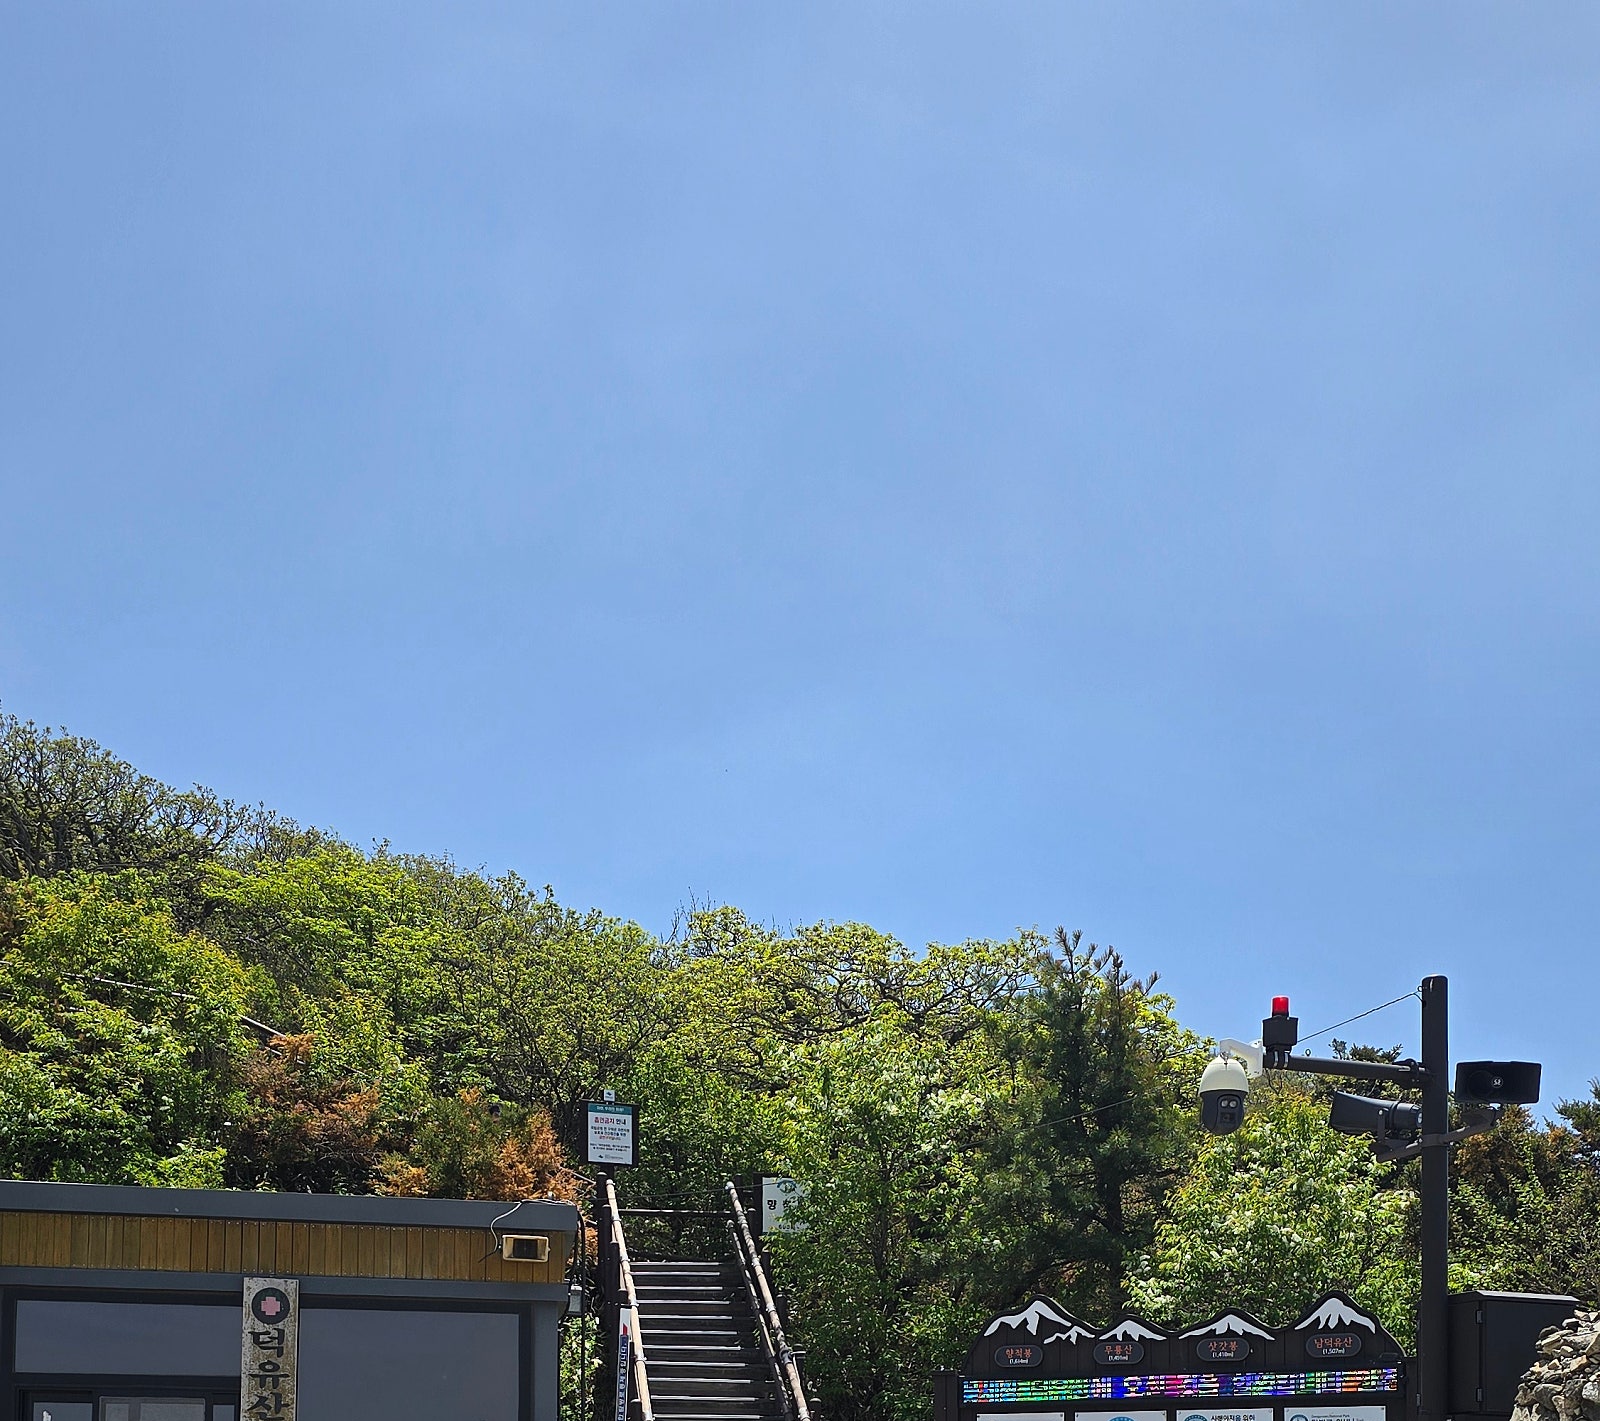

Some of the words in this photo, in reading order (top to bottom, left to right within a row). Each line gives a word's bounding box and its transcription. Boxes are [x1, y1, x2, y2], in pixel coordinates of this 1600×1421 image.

[1208, 1341, 1238, 1351] 삿갓봉
[1315, 1337, 1352, 1348] 남덕유산
[1006, 1348, 1032, 1358] 향적봉
[1105, 1345, 1132, 1355] 무룡산
